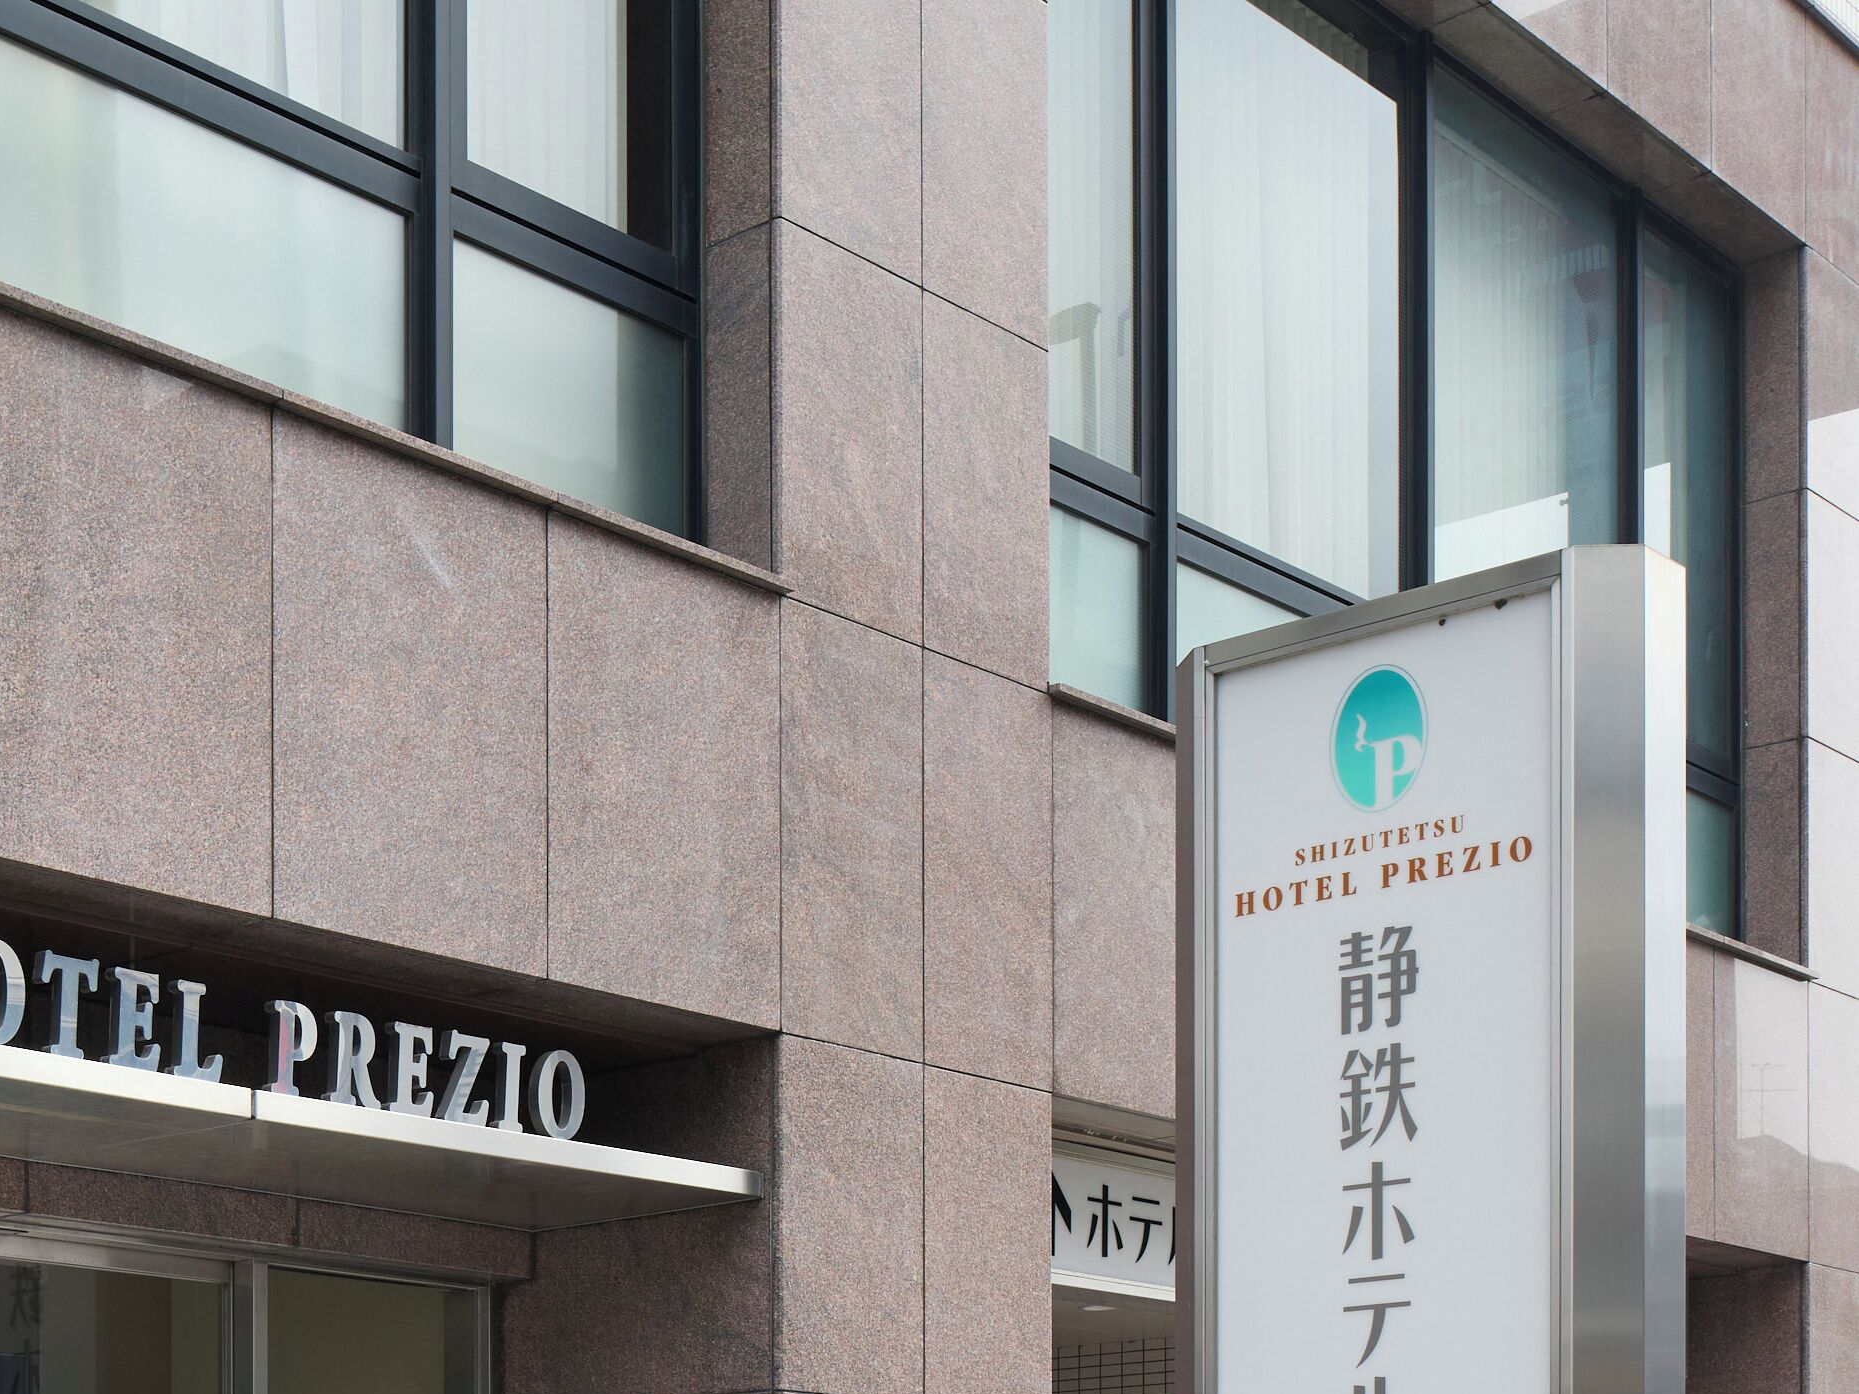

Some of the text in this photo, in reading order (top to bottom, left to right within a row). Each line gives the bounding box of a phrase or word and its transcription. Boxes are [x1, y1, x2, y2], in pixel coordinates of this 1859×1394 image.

[1234, 835, 1533, 918] HOTEL PREZIO
[1294, 814, 1465, 867] SHIZUTETSU
[266, 998, 586, 1141] PREZIO
